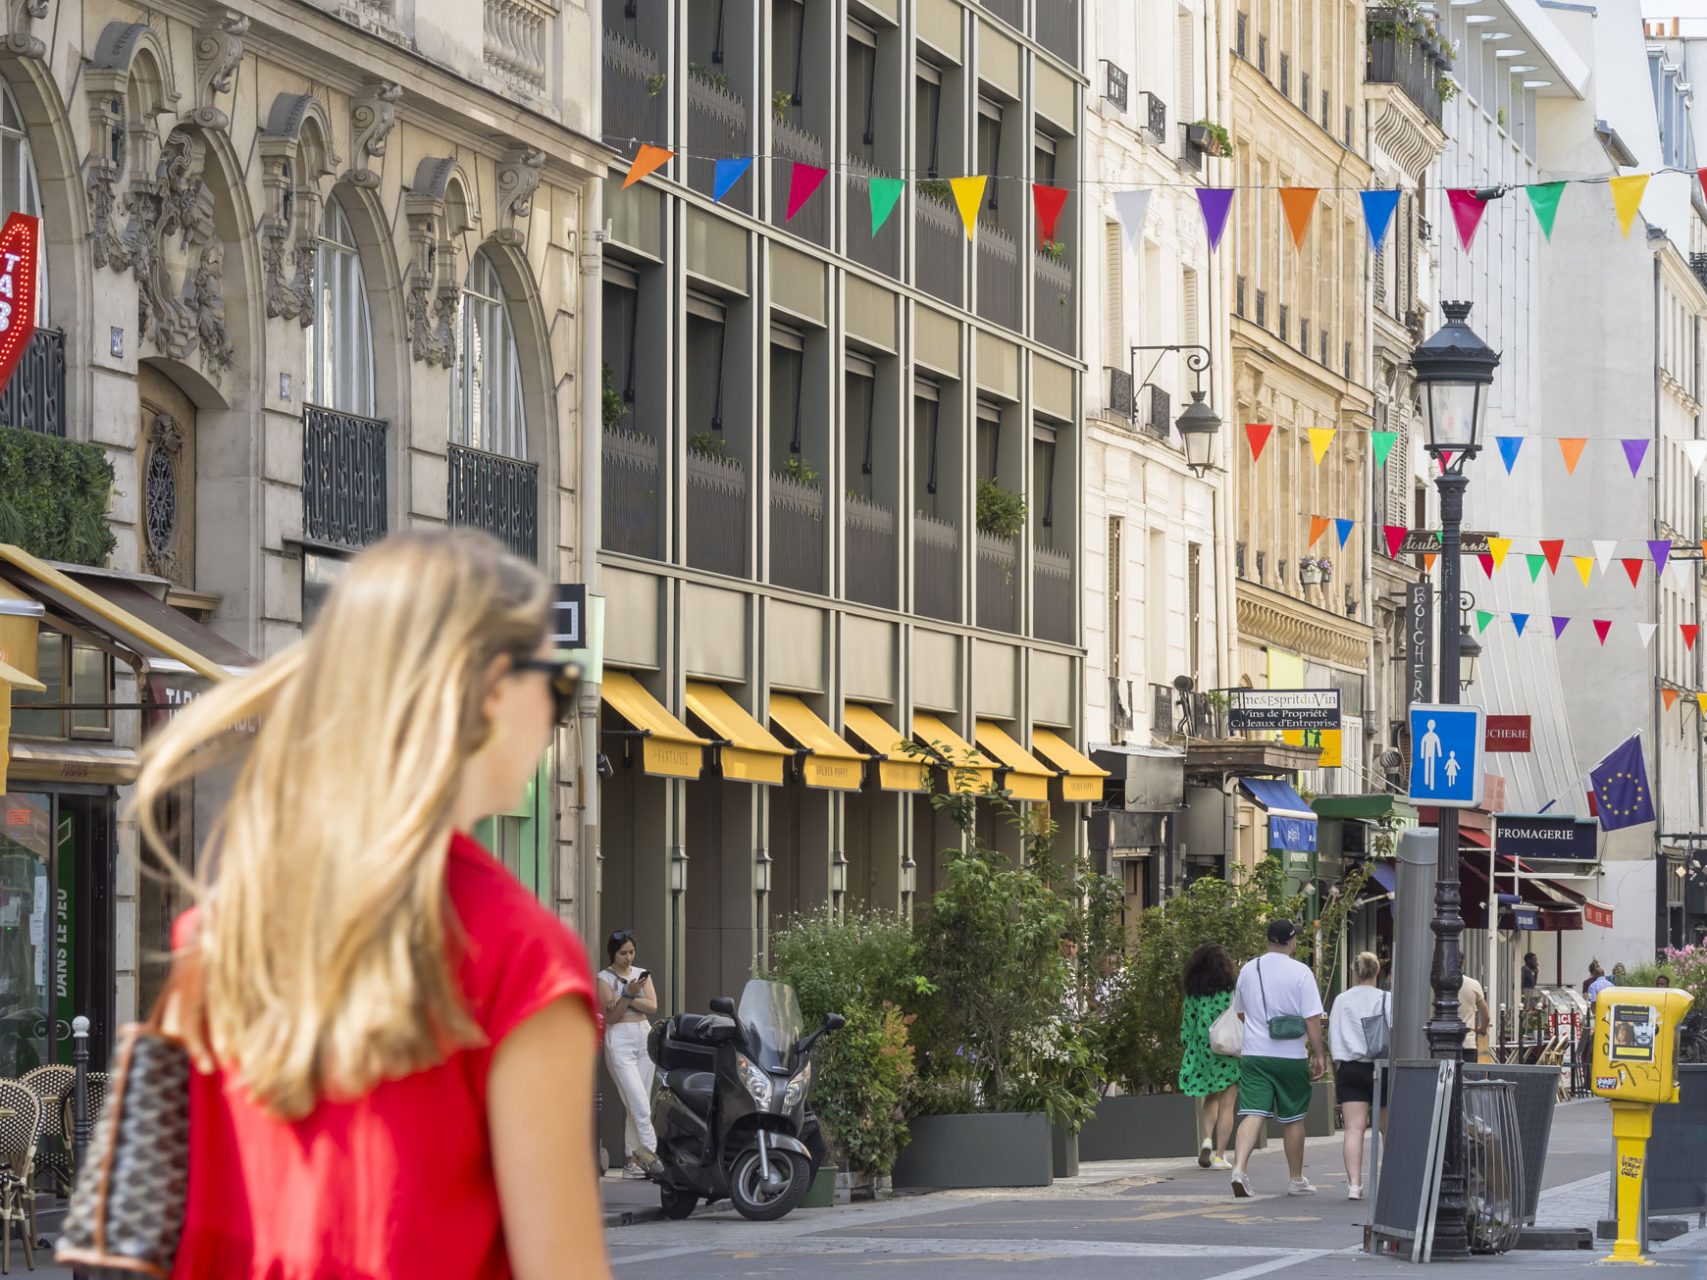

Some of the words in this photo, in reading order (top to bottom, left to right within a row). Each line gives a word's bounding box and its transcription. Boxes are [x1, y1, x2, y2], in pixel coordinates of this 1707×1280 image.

[1413, 586, 1425, 704] BOUCHER
[1267, 710, 1279, 718] de
[1282, 709, 1328, 721] Propriété
[1278, 719, 1338, 730] d'Entreprise
[1498, 828, 1574, 840] FROMAGERIE
[56, 888, 67, 920] JEU
[56, 924, 67, 944] LE
[56, 948, 67, 998] DANS
